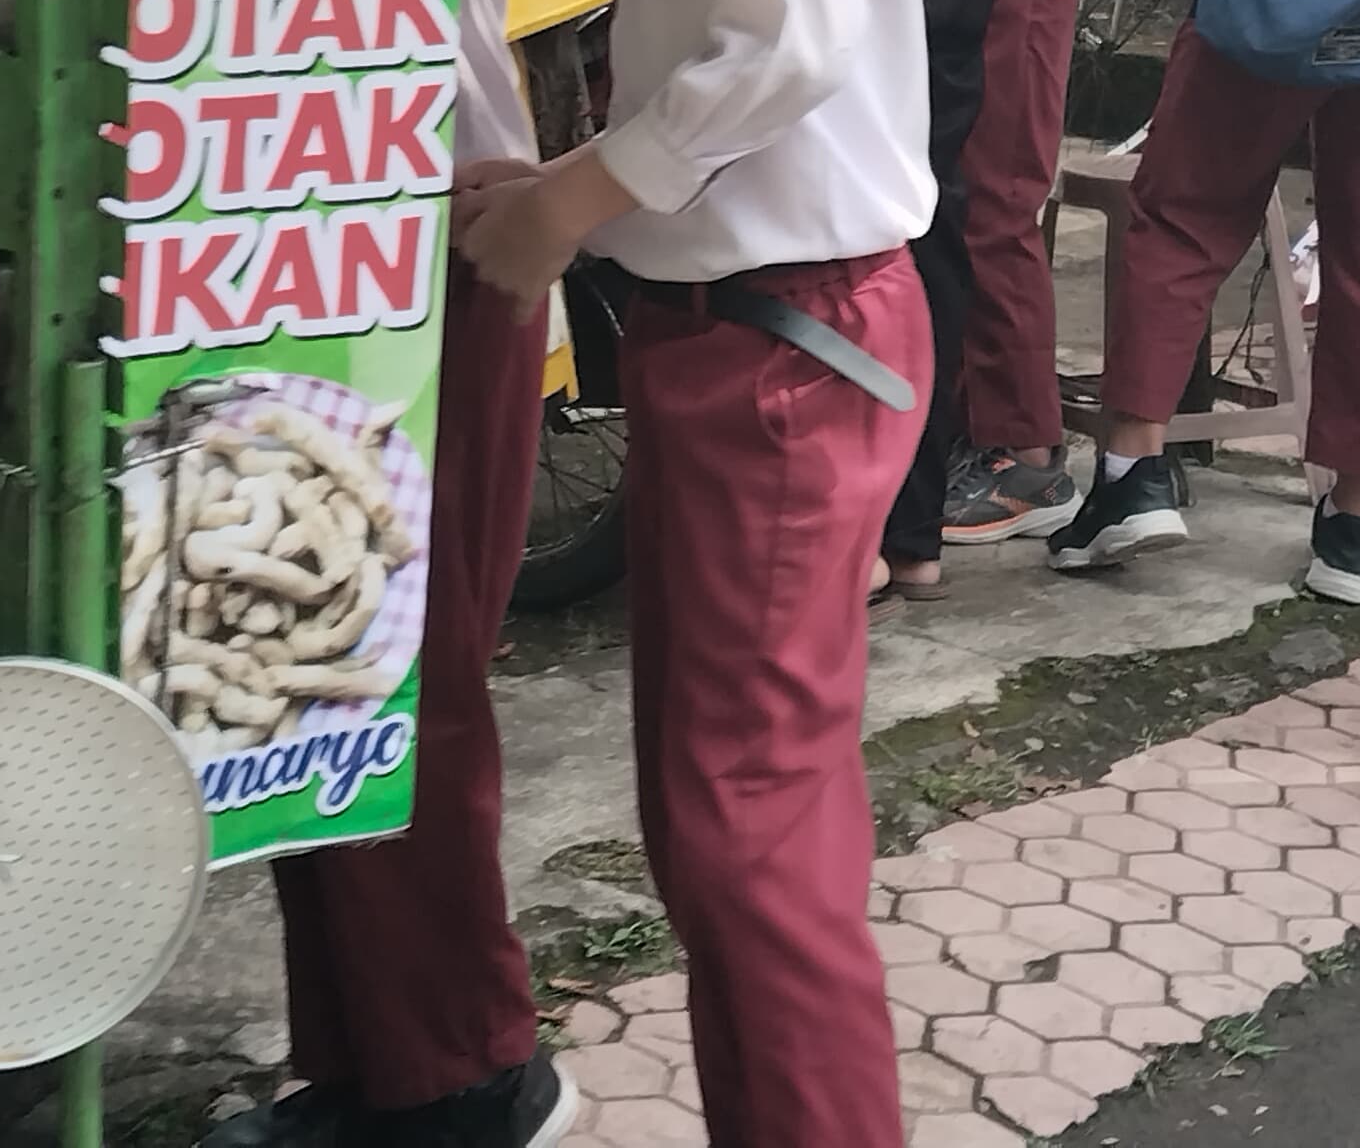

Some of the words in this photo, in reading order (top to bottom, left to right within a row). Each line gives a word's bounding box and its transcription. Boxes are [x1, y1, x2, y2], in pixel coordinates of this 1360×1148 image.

[126, 83, 445, 203] OTAK
[123, 216, 423, 340] IKAN
[201, 721, 408, 806] unaryo
